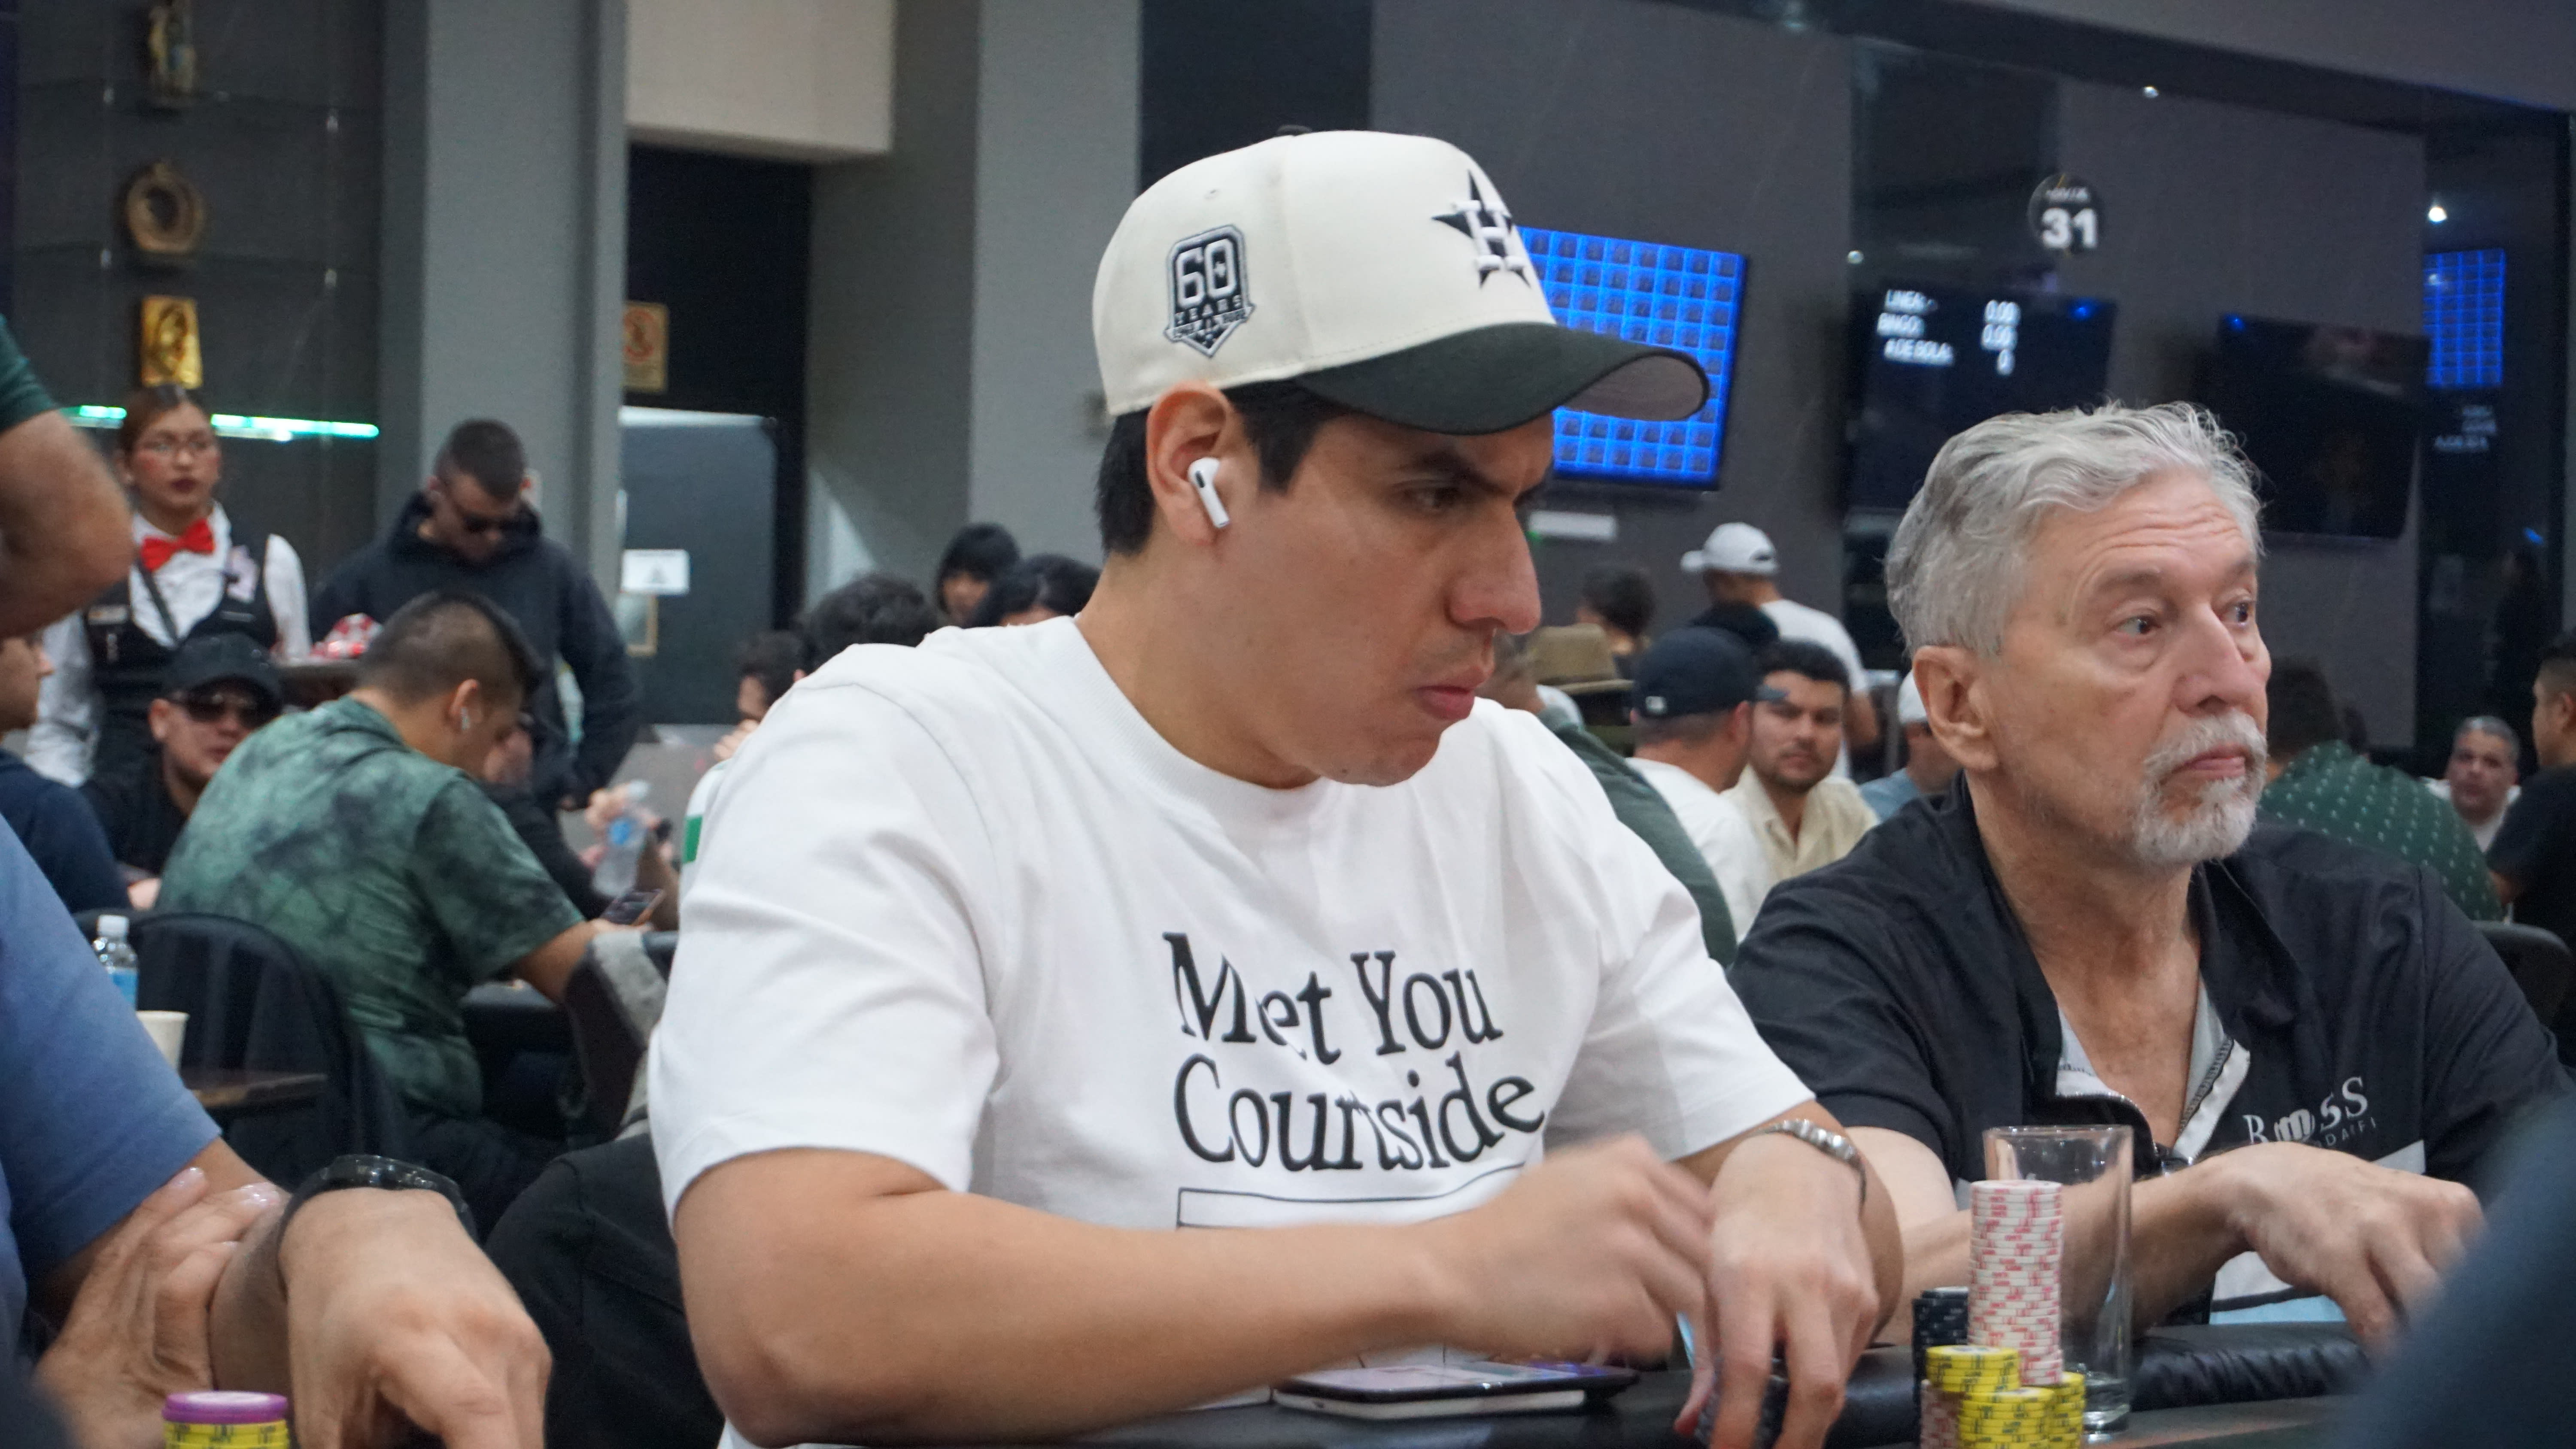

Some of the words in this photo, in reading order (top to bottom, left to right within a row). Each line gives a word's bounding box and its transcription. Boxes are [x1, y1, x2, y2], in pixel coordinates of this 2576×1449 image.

[2042, 208, 2098, 248] 31
[1176, 238, 1236, 309] 60
[1162, 932, 1341, 1065] Met
[1350, 950, 1504, 1056] You
